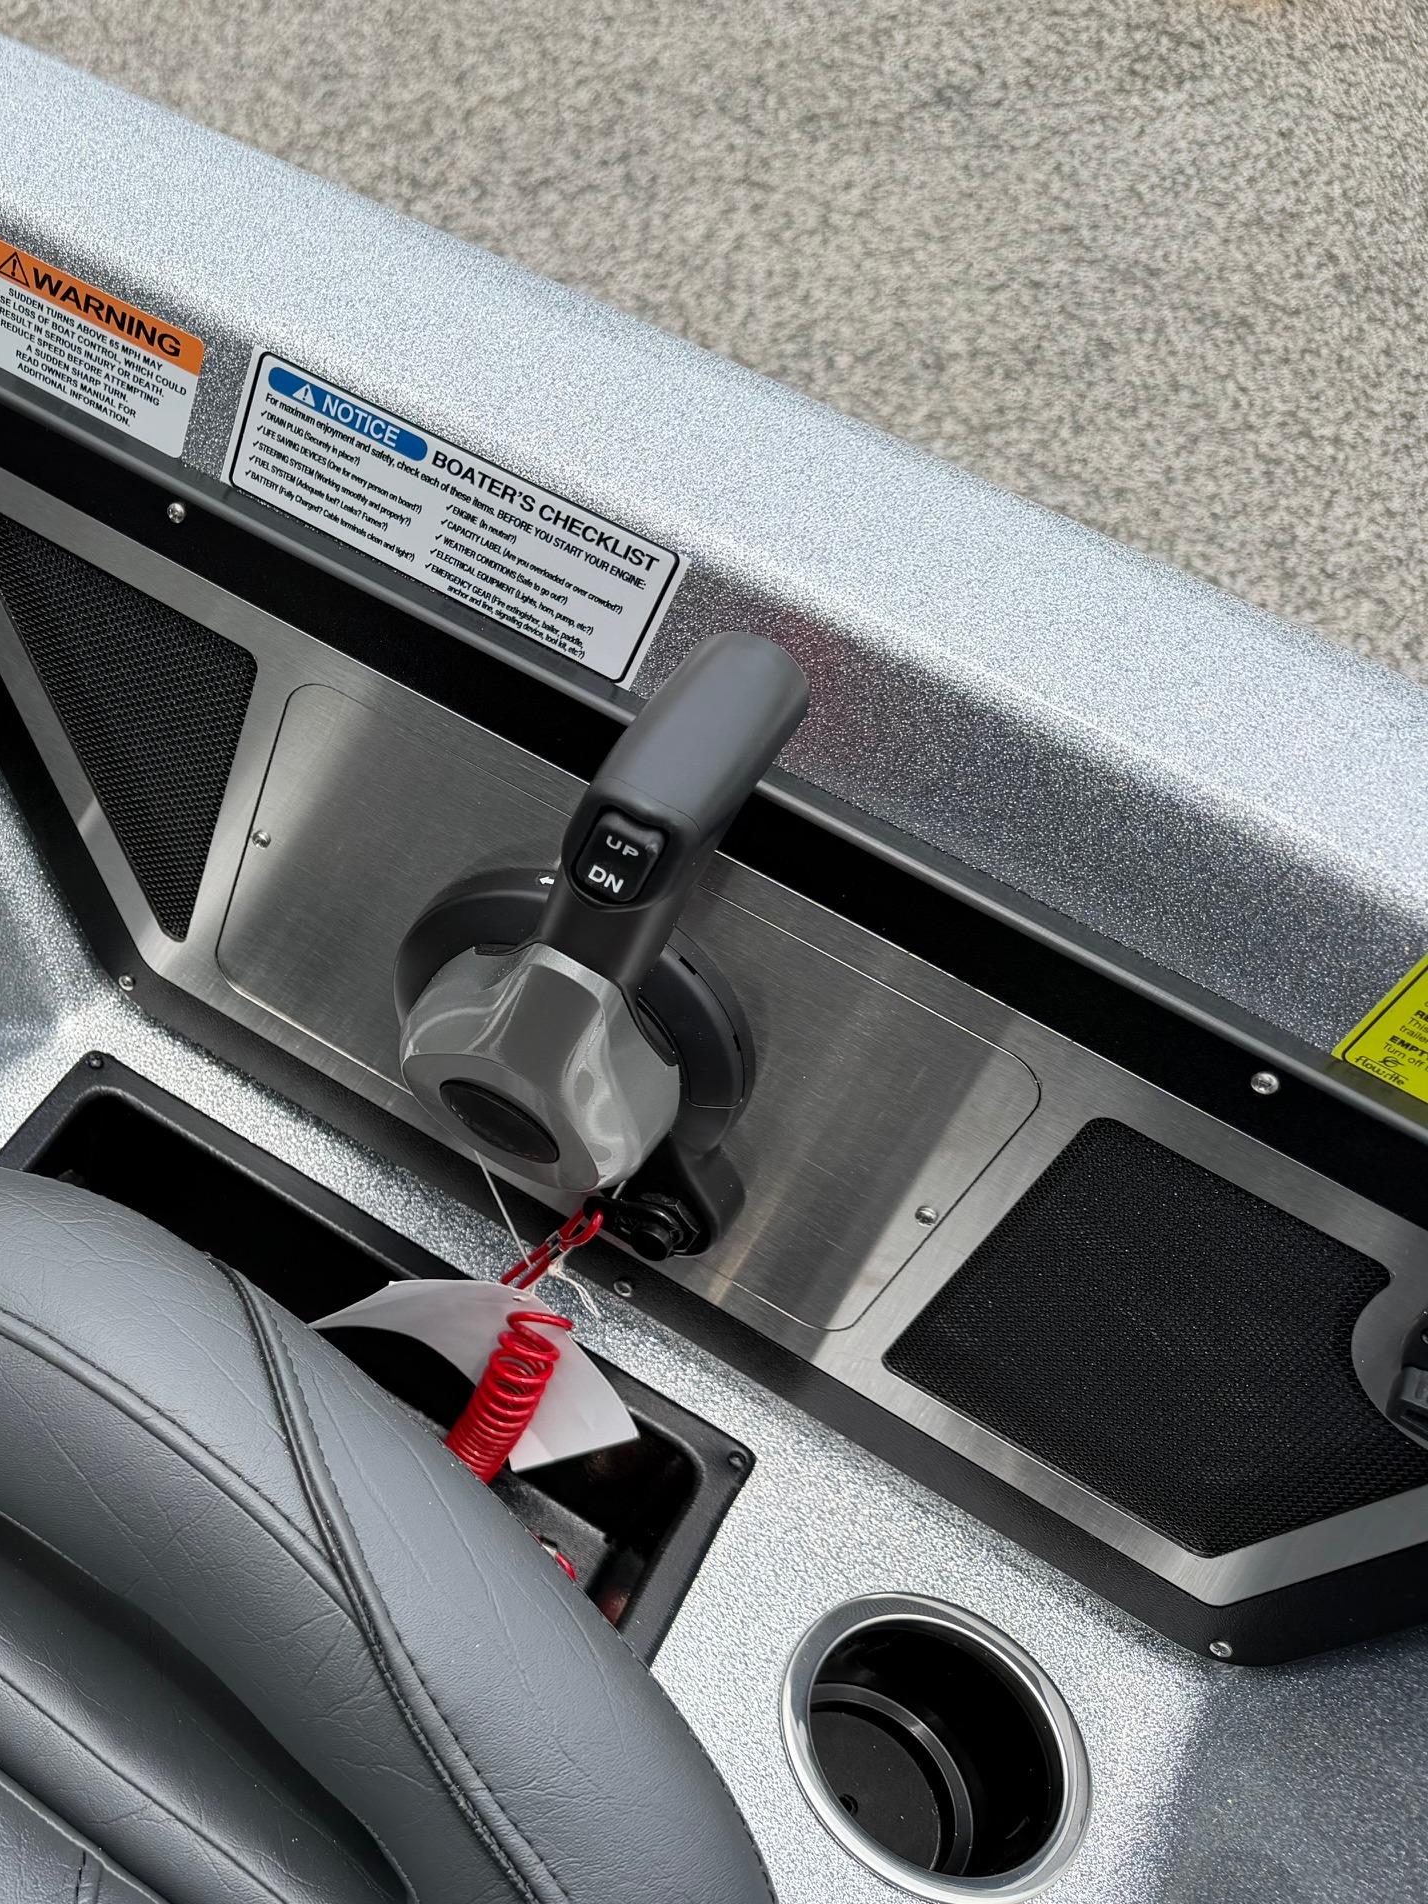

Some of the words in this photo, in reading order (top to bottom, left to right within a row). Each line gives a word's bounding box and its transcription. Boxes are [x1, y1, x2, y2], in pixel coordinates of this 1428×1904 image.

[8, 287, 43, 312] SUDDEN
[45, 305, 74, 328] TURNS
[76, 321, 107, 344] ABOVE
[109, 337, 119, 350] 65
[121, 343, 140, 361] MPH
[142, 354, 163, 372] MAY
[13, 301, 35, 320] LOSS
[37, 313, 49, 327] OF
[51, 320, 75, 340] BOAT
[76, 334, 121, 364] CONTROL,
[123, 357, 153, 379] WHICH
[155, 373, 187, 396] COULD
[31, 266, 182, 359] WARNING
[0, 306, 31, 329] RESULT
[33, 323, 42, 335] IN
[44, 329, 82, 355] SERIOUS
[84, 349, 115, 372] INJURY
[117, 366, 130, 380] OR
[132, 373, 164, 397] DEATH.
[0, 318, 35, 343] REDUCE
[36, 337, 64, 358] SPEED
[67, 352, 102, 377] BEFORE
[103, 371, 159, 407] ATTEMPTING
[15, 349, 38, 367] READ
[40, 362, 77, 388] OWNERS
[80, 382, 116, 408] MANUAL
[117, 402, 136, 418] FOR
[26, 343, 32, 353] A
[34, 347, 69, 372] SUDDEN
[71, 366, 101, 388] SHARP
[102, 382, 128, 402] TURN.
[17, 361, 67, 394] ADDITIONAL
[69, 388, 130, 427] INFORMATION.
[321, 393, 400, 448] NOTICE
[265, 392, 279, 407] For
[278, 399, 315, 425] maximum
[315, 418, 355, 447] enjoyment
[354, 438, 370, 453] and
[369, 446, 396, 468] safety,
[396, 459, 420, 478] check
[420, 471, 440, 488] each
[440, 481, 450, 493] of
[449, 485, 472, 504] these
[471, 496, 496, 516] items.
[496, 509, 533, 534] BEFORE
[532, 527, 553, 544] YOU
[552, 536, 583, 558] START
[582, 552, 609, 571] YOUR
[608, 564, 647, 590] ENGINE:
[431, 449, 537, 513] BOATER'S
[536, 502, 659, 574] CHECKLIST
[587, 864, 624, 894] DN
[606, 835, 639, 857] UP
[1383, 1041, 1406, 1058] Turn
[1407, 1057, 1425, 1067] off
